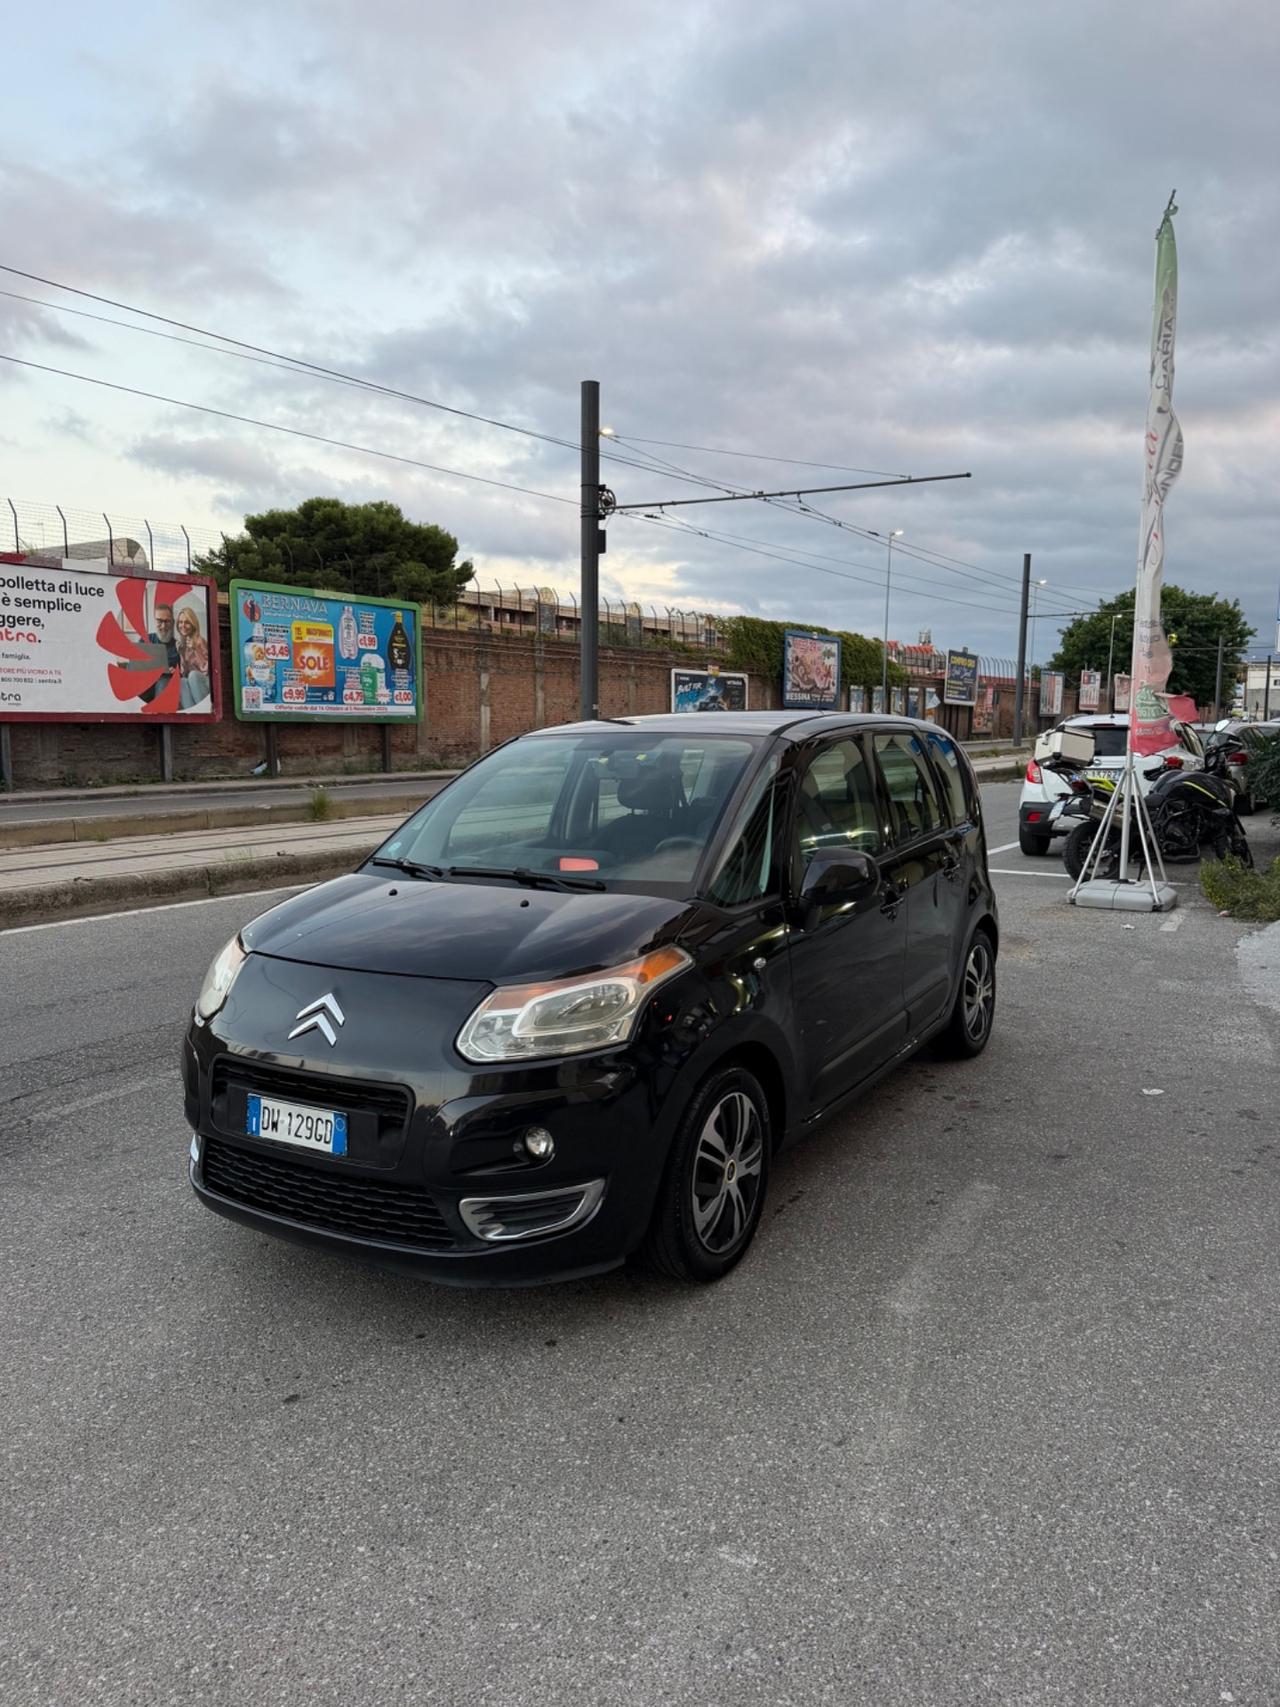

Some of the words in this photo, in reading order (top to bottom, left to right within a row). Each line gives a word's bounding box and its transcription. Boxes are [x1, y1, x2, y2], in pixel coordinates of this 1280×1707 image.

[58, 580, 72, 594] di
[75, 582, 105, 597] luce
[2, 592, 11, 606] è
[14, 597, 82, 613] semplice
[299, 656, 329, 671] SOLE
[261, 1106, 280, 1133] DW
[287, 1111, 333, 1144] 129GD
